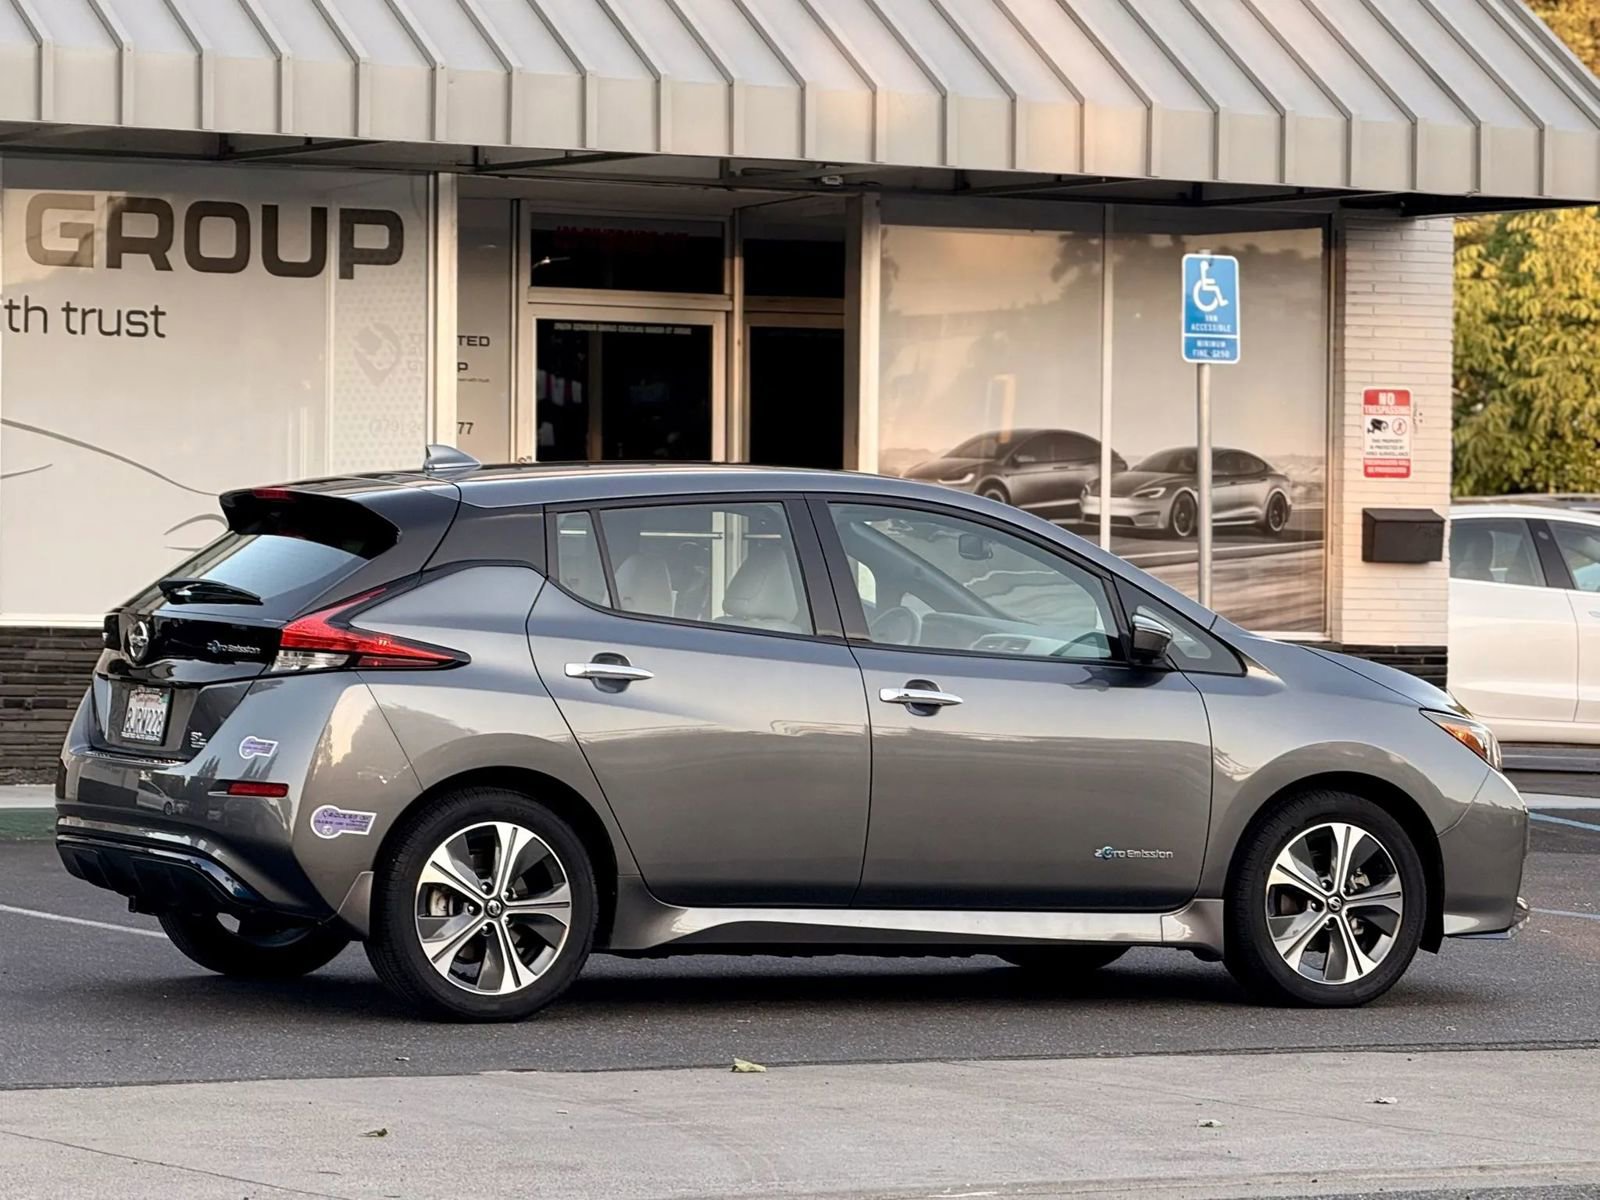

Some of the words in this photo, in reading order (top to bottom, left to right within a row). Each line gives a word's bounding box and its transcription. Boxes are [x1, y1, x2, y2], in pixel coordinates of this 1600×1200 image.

[26, 192, 404, 280] GROUP
[4, 295, 48, 333] th
[61, 301, 166, 338] trust
[1191, 323, 1231, 333] ACCESSIBLE
[1378, 391, 1396, 406] NO
[1126, 849, 1174, 859] Emission
